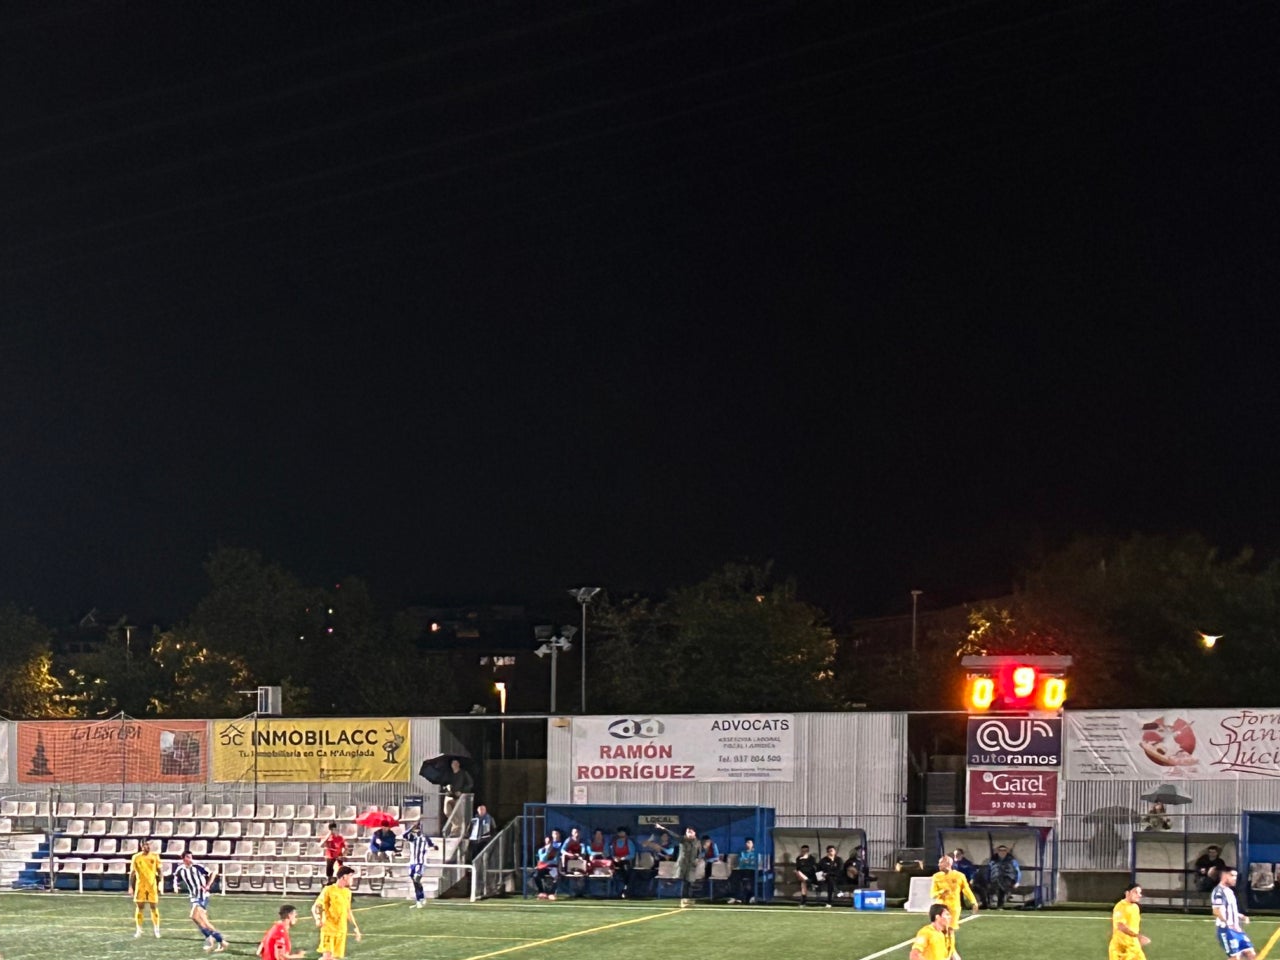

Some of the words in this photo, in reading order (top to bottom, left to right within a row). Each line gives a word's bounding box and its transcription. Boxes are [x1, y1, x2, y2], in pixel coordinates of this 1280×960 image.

[1013, 667, 1035, 697] 9
[972, 678, 994, 709] 0
[1044, 678, 1066, 708] 0
[711, 720, 789, 731] ADVOCATS
[251, 730, 378, 746] INMOBILACC
[304, 750, 314, 758] en
[316, 750, 327, 758] Ca
[600, 741, 672, 759] RAMÓN
[972, 754, 1057, 764] autoramos
[577, 762, 695, 779] RODRÍGUEZ
